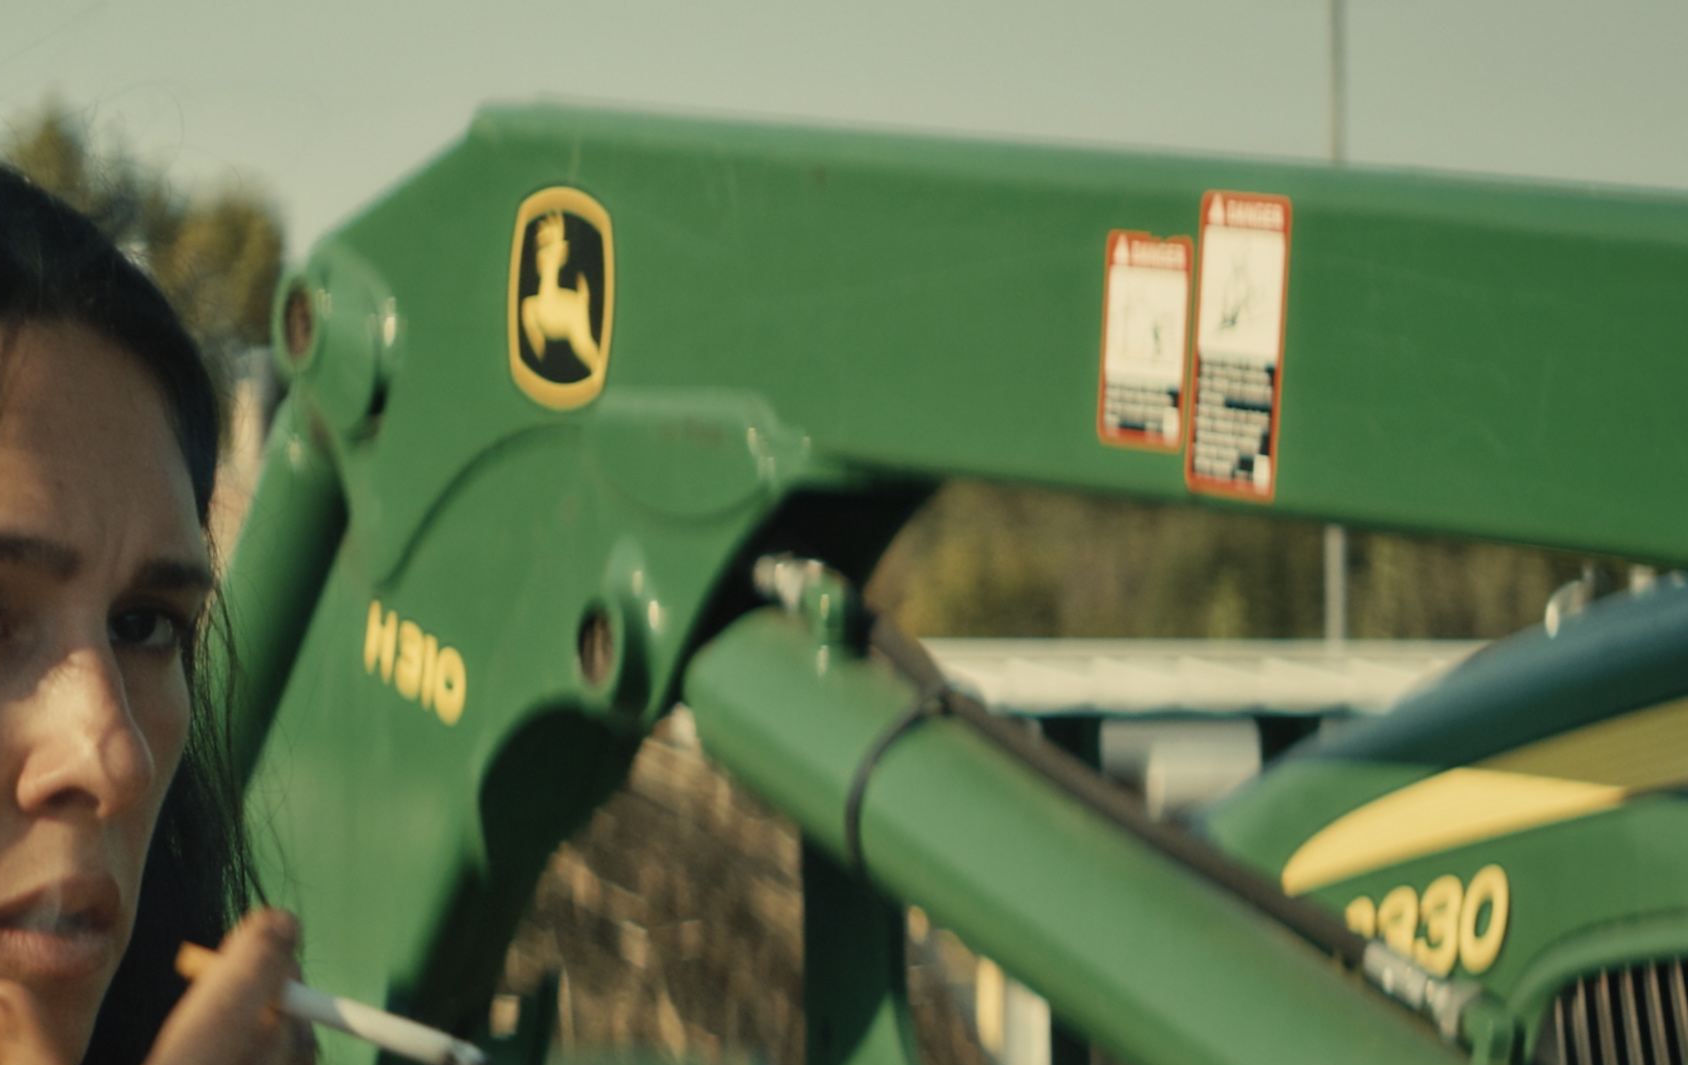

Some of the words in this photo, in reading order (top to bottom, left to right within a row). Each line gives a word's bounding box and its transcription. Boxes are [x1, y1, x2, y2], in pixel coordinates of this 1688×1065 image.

[1226, 199, 1285, 229] DANGER
[1130, 240, 1187, 269] DANGER
[364, 599, 467, 727] H310
